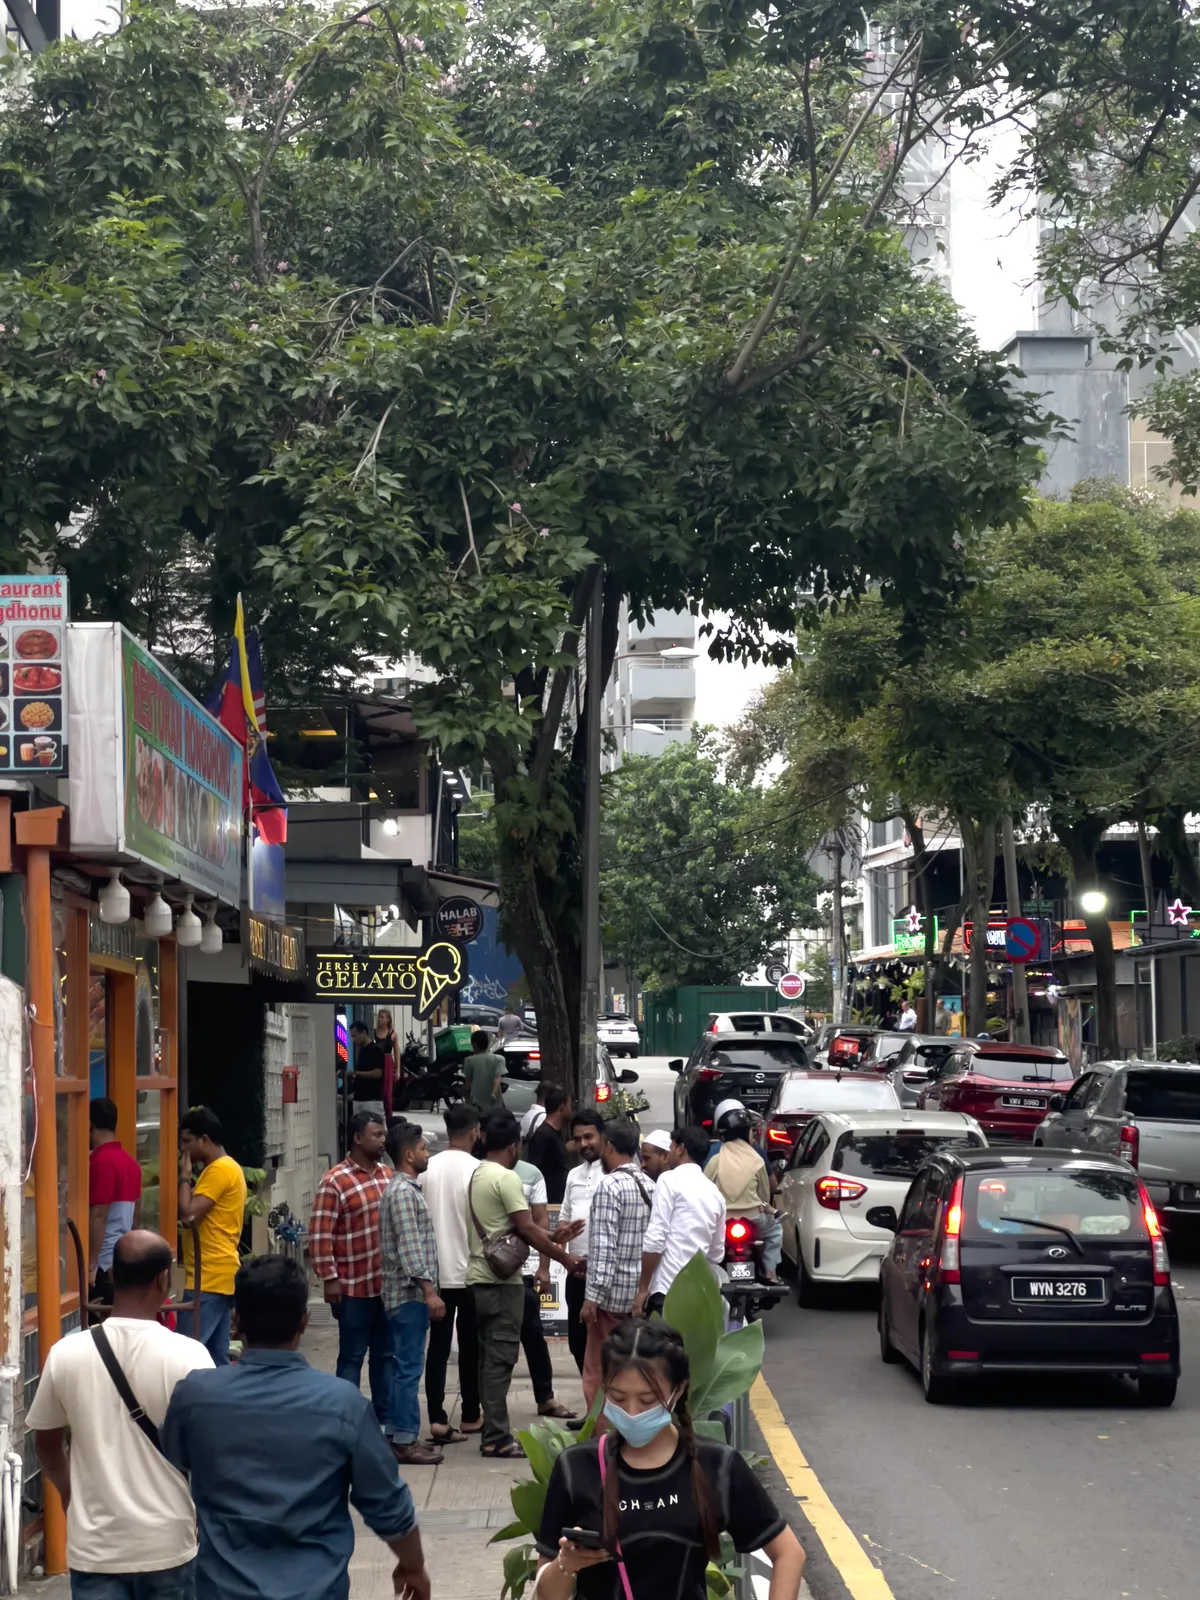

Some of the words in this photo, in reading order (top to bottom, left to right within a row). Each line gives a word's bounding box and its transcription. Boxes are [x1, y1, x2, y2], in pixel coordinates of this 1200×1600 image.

[0, 580, 62, 597] aurant
[440, 908, 477, 920] HALAB
[317, 962, 369, 971] JERSEY
[378, 963, 415, 972] JACK
[315, 970, 417, 989] GELATO
[1030, 1282, 1053, 1296] WYN
[1056, 1282, 1087, 1296] 3276
